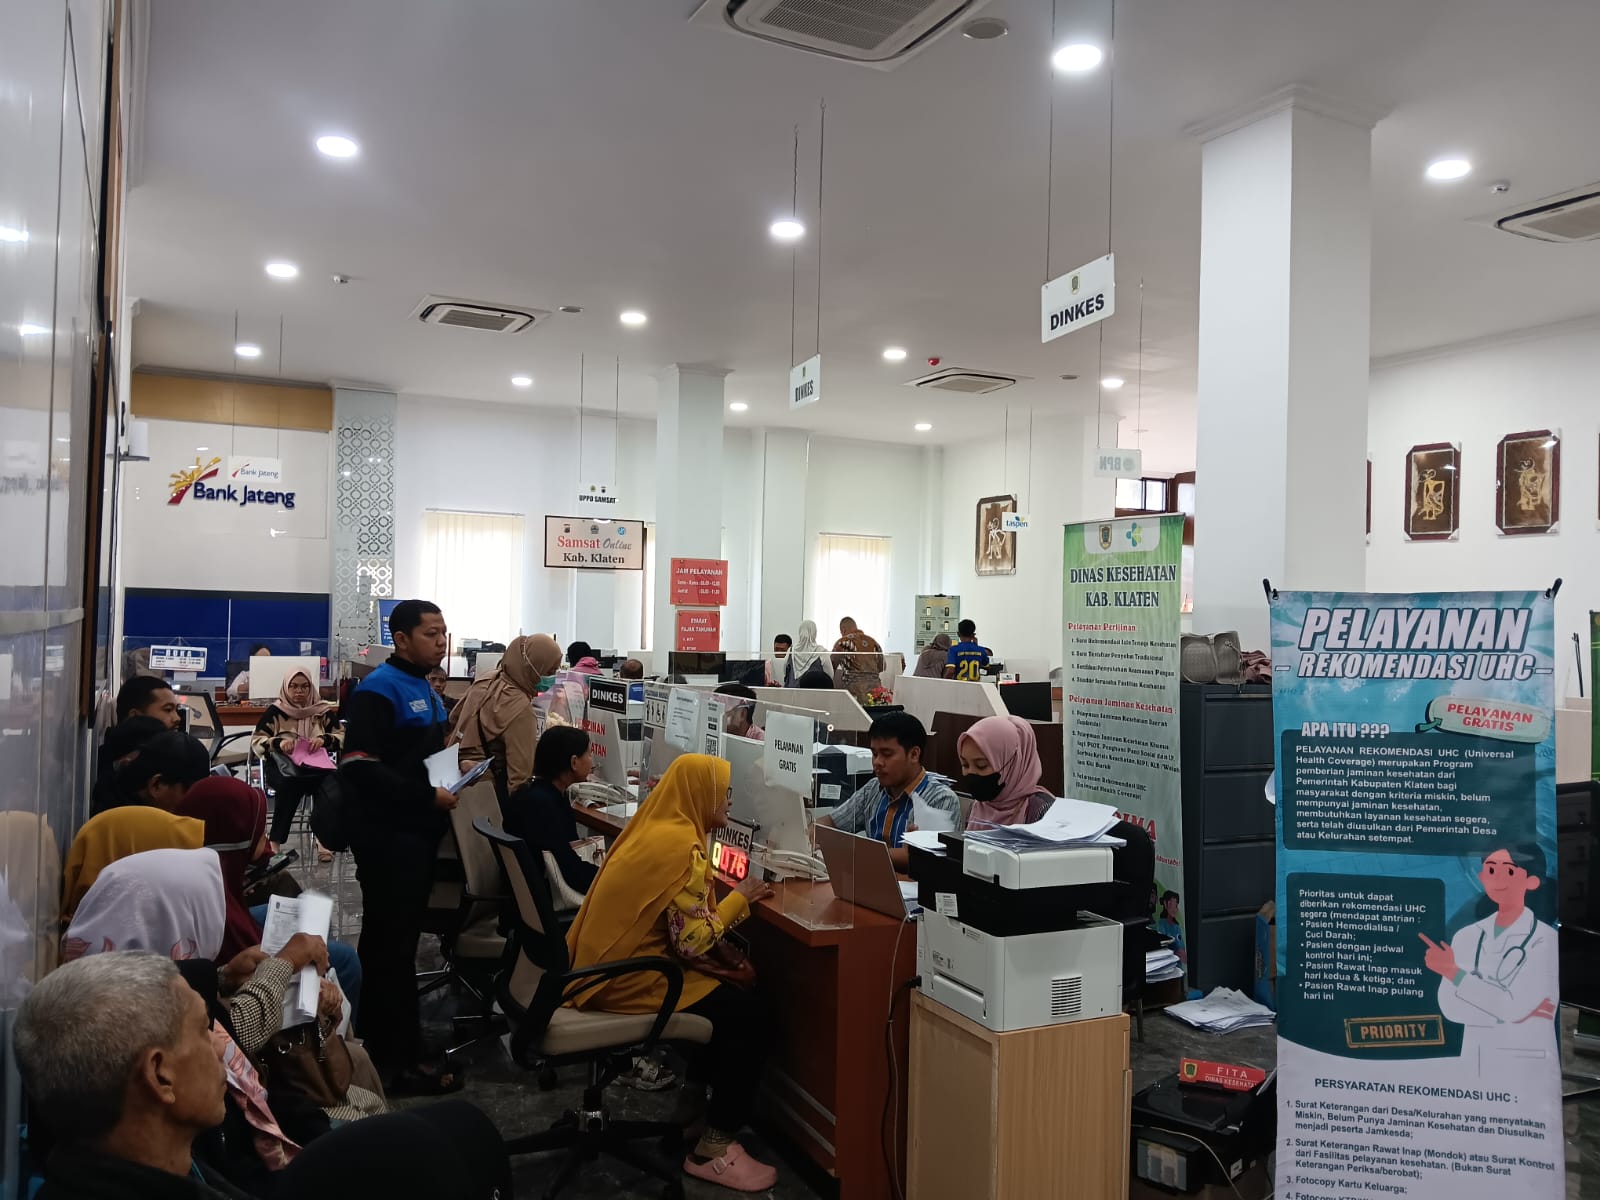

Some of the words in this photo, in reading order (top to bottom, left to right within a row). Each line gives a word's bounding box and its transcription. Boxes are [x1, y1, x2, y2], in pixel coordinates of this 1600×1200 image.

[1050, 293, 1105, 331] DINKES
[795, 379, 814, 402] DINKES
[240, 467, 256, 477] Bank
[193, 481, 238, 502] Bank
[240, 484, 296, 509] Jateng
[1006, 519, 1028, 529] taspen
[557, 535, 601, 549] Samsat
[602, 537, 632, 551] Online
[563, 552, 588, 564] Kab.
[591, 553, 625, 565] Klaten
[1070, 566, 1104, 584] DINAS
[1106, 564, 1177, 583] KESEHATAN
[1086, 591, 1112, 607] KAB.
[1114, 591, 1159, 607] KLATEN
[1298, 607, 1532, 651] PELAYANAN
[956, 660, 980, 681] 20
[1298, 653, 1472, 680] REKOMENDASI
[1477, 655, 1537, 681] UHC
[592, 689, 624, 704] DINKES
[1447, 703, 1533, 723] PELAYANAN
[1301, 721, 1330, 738] APA
[1332, 722, 1358, 738] ITU
[1360, 723, 1390, 739] ???
[1462, 716, 1515, 732] GRATIS
[774, 739, 804, 755] PELAYANAN
[1296, 745, 1354, 755] PELAYANAN
[1359, 747, 1433, 757] REKOMENDASI
[1438, 749, 1459, 757] UHC
[1464, 749, 1514, 760] (Universal
[779, 759, 797, 773] GRATIS
[1296, 756, 1325, 764] Health
[1327, 757, 1376, 768] Coverage)
[1378, 760, 1431, 769] merupakan
[1433, 760, 1474, 770] Program
[1296, 767, 1344, 777] pemberian
[1346, 768, 1384, 777] jaminan
[1386, 769, 1435, 778] kesehatan
[1437, 771, 1456, 779] dari
[1296, 777, 1348, 786] Pemerintah
[1351, 779, 1402, 789] Kabupaten
[1404, 781, 1435, 789] Klaten
[1437, 782, 1457, 791] bagi
[1296, 788, 1349, 799] masyarakat
[1351, 790, 1386, 800] dengan
[1389, 791, 1422, 800] kriteria
[1460, 793, 1491, 802] belum
[1351, 800, 1389, 810] jaminan
[1391, 802, 1442, 812] kesehatan,
[1296, 810, 1362, 819] membutuhkan
[1364, 812, 1401, 822] layanan
[1403, 813, 1452, 822] kesehatan
[1296, 821, 1319, 829] serta
[1321, 822, 1344, 830] telah
[1346, 822, 1392, 831] diusulkan
[1395, 824, 1413, 832] dari
[1416, 825, 1470, 834] Pemerintah
[1472, 826, 1497, 835] Desa
[1296, 831, 1316, 839] atau
[1318, 831, 1366, 841] Kelurahan
[1368, 834, 1415, 844] setempat.
[1299, 889, 1336, 898] Prioritas
[1338, 891, 1365, 900] untuk
[1367, 892, 1394, 902] dapat
[1300, 900, 1340, 909] diberikan
[1342, 902, 1402, 912] rekomendasi
[1404, 905, 1426, 913] UHC
[1300, 910, 1328, 920] segera
[1330, 912, 1379, 923] (mendapat
[1382, 914, 1415, 923] antrian
[1305, 920, 1334, 929] Pasien
[1336, 922, 1394, 932] Hemodialisa
[1305, 931, 1323, 939] Cuci
[1325, 931, 1357, 941] Darah;
[1306, 941, 1334, 950] Pasien
[1336, 942, 1371, 952] dengan
[1373, 944, 1404, 953] jadwal
[1305, 951, 1335, 959] kontrol
[1337, 952, 1356, 961] hari
[1358, 954, 1373, 963] ini;
[1306, 962, 1334, 970] Pasien
[1336, 963, 1366, 972] Rawat
[1368, 964, 1389, 975] Inap
[1391, 967, 1423, 976] masuk
[1304, 971, 1321, 980] hari
[1323, 972, 1351, 981] kedua
[1397, 977, 1416, 985] dan
[1304, 982, 1334, 990] Pasien
[1336, 983, 1366, 992] Rawat
[1368, 984, 1389, 995] Inap
[1391, 986, 1424, 998] pulang
[1323, 992, 1334, 1000] ini
[1360, 1023, 1427, 1040] PRIORITY
[1217, 1066, 1248, 1079] FITA
[1224, 1079, 1257, 1089] KESEHATA
[1314, 1078, 1395, 1093] PERSYARATAN
[1398, 1084, 1483, 1101] REKOMENDASI
[1486, 1091, 1511, 1102] UHC
[1295, 1100, 1317, 1109] Surat
[1319, 1101, 1370, 1113] Keterangan
[1372, 1105, 1389, 1115] dari
[1391, 1107, 1462, 1120] Desa/Kelurahan
[1464, 1114, 1487, 1125] yang
[1489, 1116, 1546, 1130] menyatakan
[1295, 1111, 1325, 1121] Miskin,
[1327, 1112, 1355, 1122] Belum
[1357, 1114, 1385, 1126] Punya
[1387, 1117, 1425, 1128] Jaminan
[1427, 1121, 1476, 1133] Kesehatan
[1497, 1126, 1545, 1140] Diusulkan
[1295, 1121, 1328, 1132] menjadi
[1331, 1124, 1364, 1134] peserta
[1365, 1126, 1414, 1139] Jamkesda;
[1295, 1138, 1318, 1147] Surat
[1320, 1140, 1371, 1152] Keterangan
[1372, 1144, 1400, 1154] Rawat
[1402, 1147, 1422, 1157] Inap
[1424, 1148, 1467, 1161] (Mondok)
[1491, 1155, 1517, 1166] Surat
[1519, 1157, 1555, 1171] Kontrol
[1295, 1149, 1312, 1158] dari
[1313, 1151, 1350, 1161] Fasilitas
[1352, 1154, 1398, 1165] pelayanan
[1400, 1157, 1449, 1170] kesehatan.
[1451, 1161, 1484, 1173] (Bukan
[1486, 1165, 1512, 1176] Surat
[1295, 1160, 1345, 1172] Keterangan
[1295, 1176, 1336, 1188] Fotocopy
[1338, 1179, 1362, 1189] Kartu
